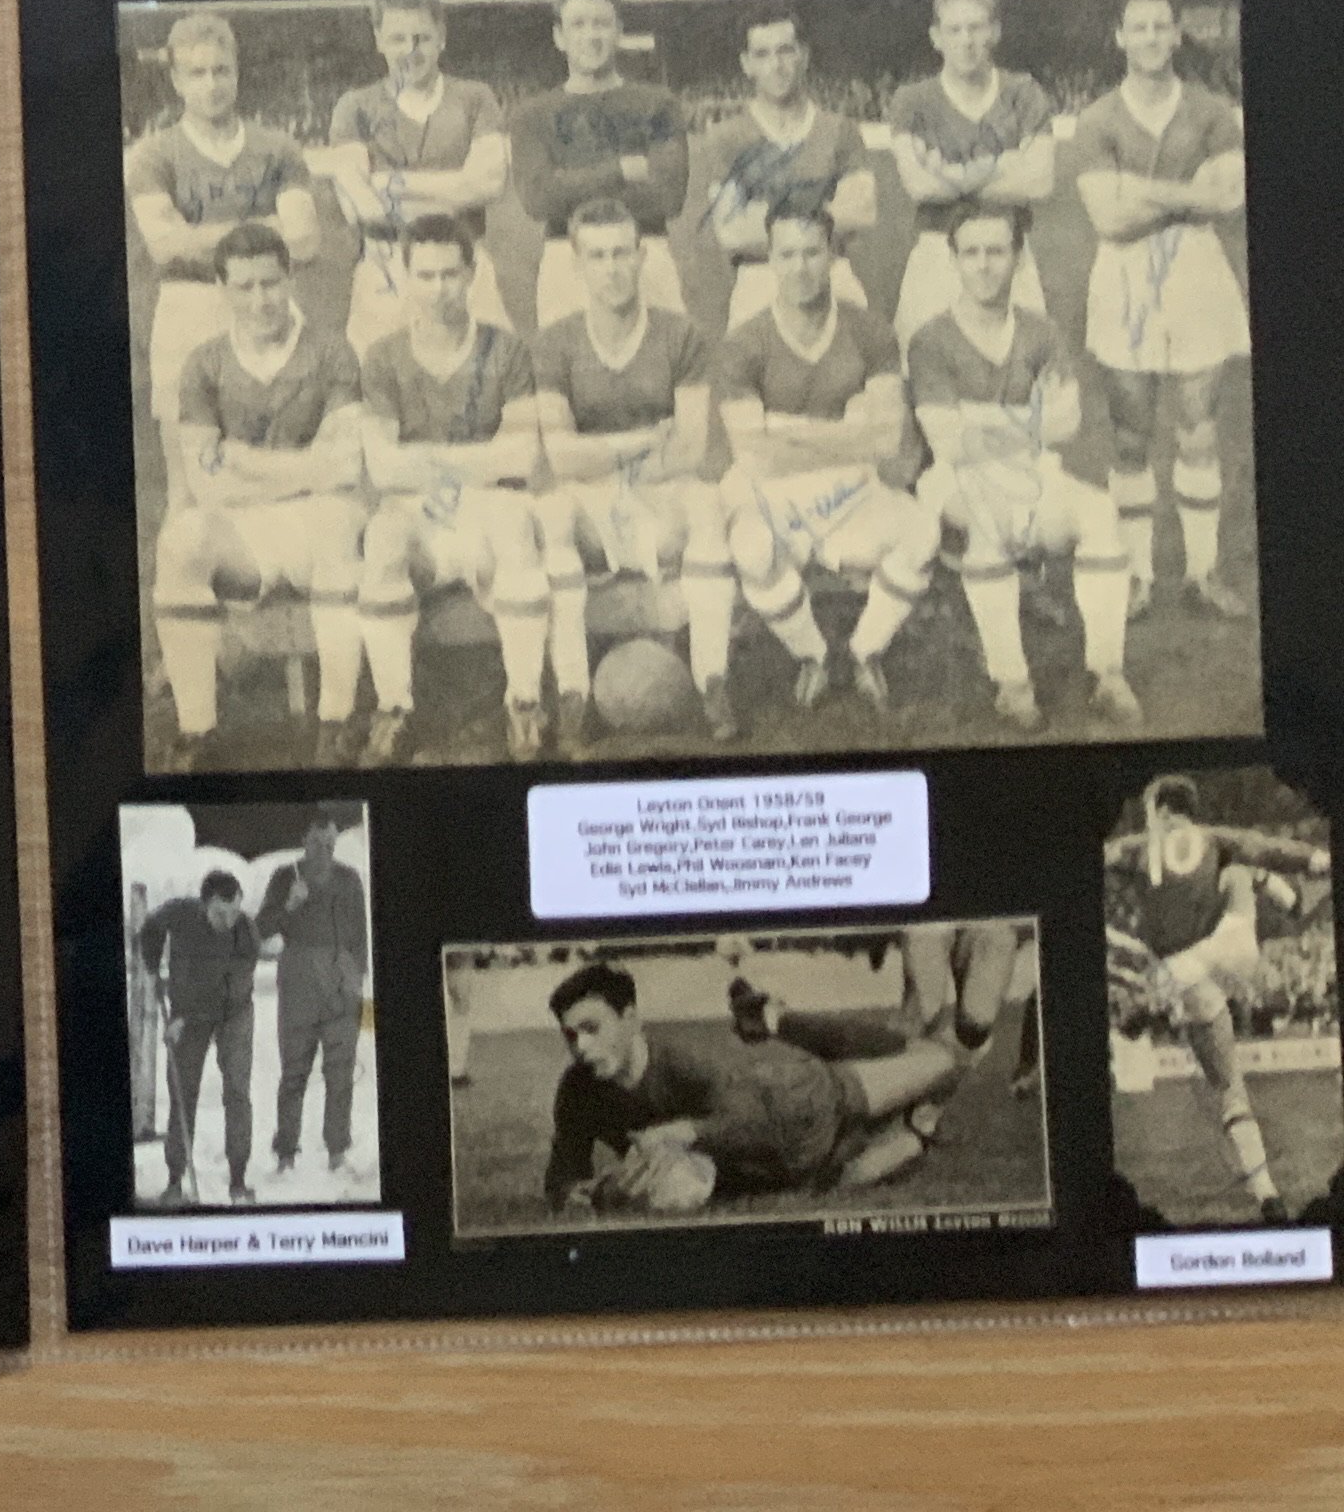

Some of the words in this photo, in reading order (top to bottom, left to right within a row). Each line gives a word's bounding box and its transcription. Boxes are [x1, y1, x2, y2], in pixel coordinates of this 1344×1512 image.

[637, 797, 693, 815] Leyton
[697, 794, 746, 812] Orient
[753, 791, 825, 809] 1958/59
[578, 821, 634, 838] George
[836, 810, 893, 828] George
[585, 840, 622, 857] John
[826, 831, 877, 848] Julians
[825, 852, 872, 871] Facey
[618, 881, 647, 898] Syd
[785, 873, 853, 890] Andrews
[128, 1236, 173, 1254] Dave
[180, 1236, 239, 1254] Harper
[247, 1233, 260, 1250] &
[267, 1232, 314, 1251] Terry
[322, 1230, 389, 1248] Mancini
